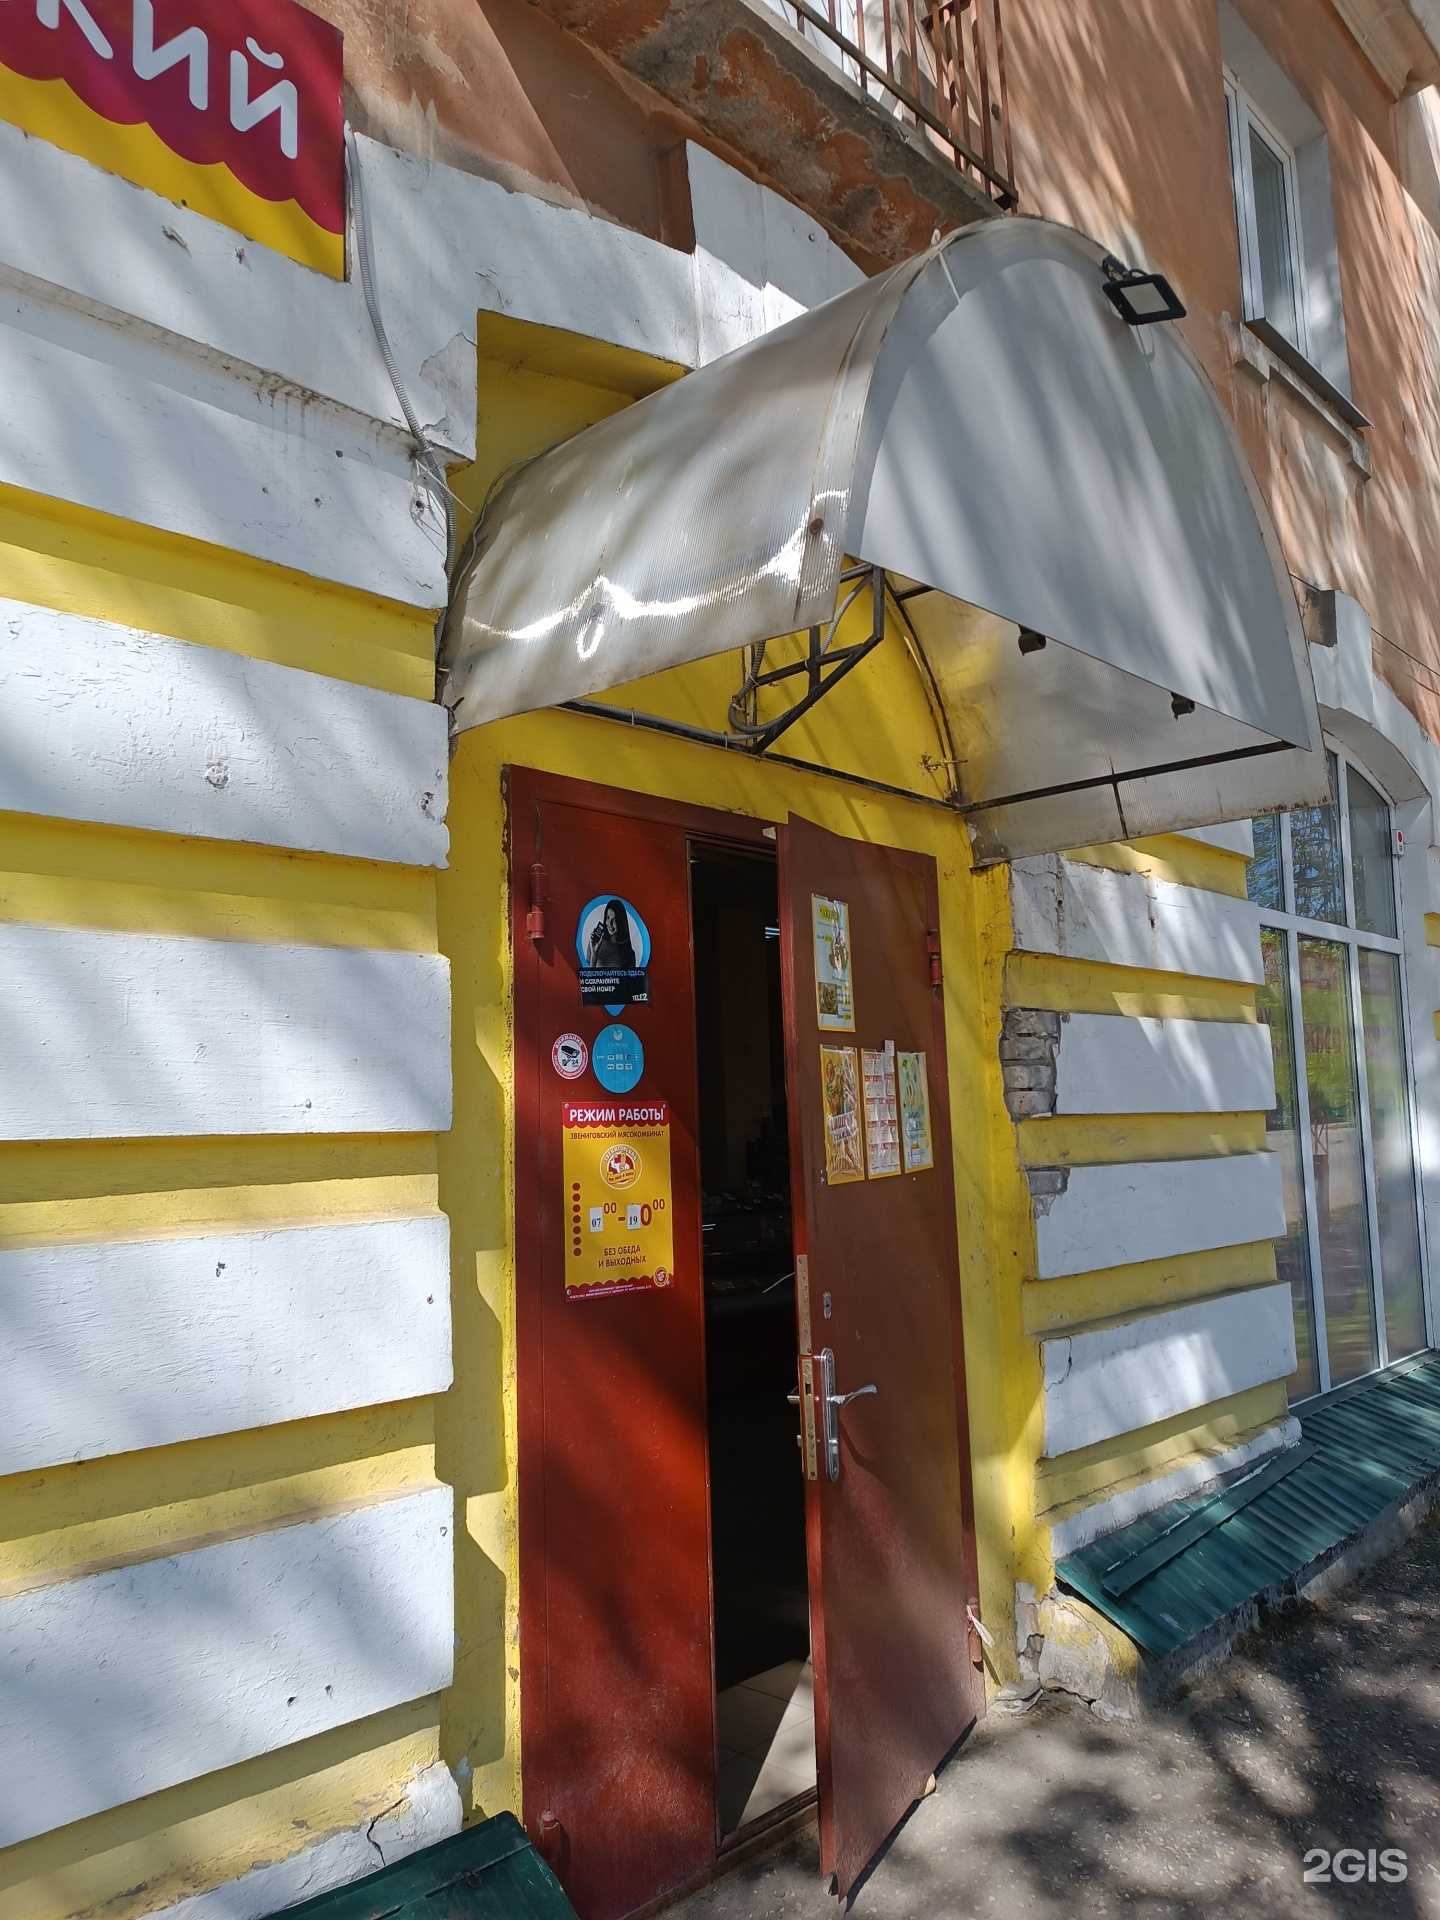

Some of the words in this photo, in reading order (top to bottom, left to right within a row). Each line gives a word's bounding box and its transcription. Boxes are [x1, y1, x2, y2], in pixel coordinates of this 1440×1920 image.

[570, 1109, 616, 1121] РЕЖИМ
[619, 1108, 664, 1120] РАБОТЫ
[570, 1131, 617, 1140] ЗВЕНИГОВСКИЙ
[618, 1130, 665, 1139] МЯСОКОМБИНАТ
[604, 1247, 616, 1256] БЕЗ
[618, 1245, 641, 1255] ОБЕДА
[598, 1260, 604, 1269] И
[606, 1256, 646, 1268] ВЫХОДНЫХ
